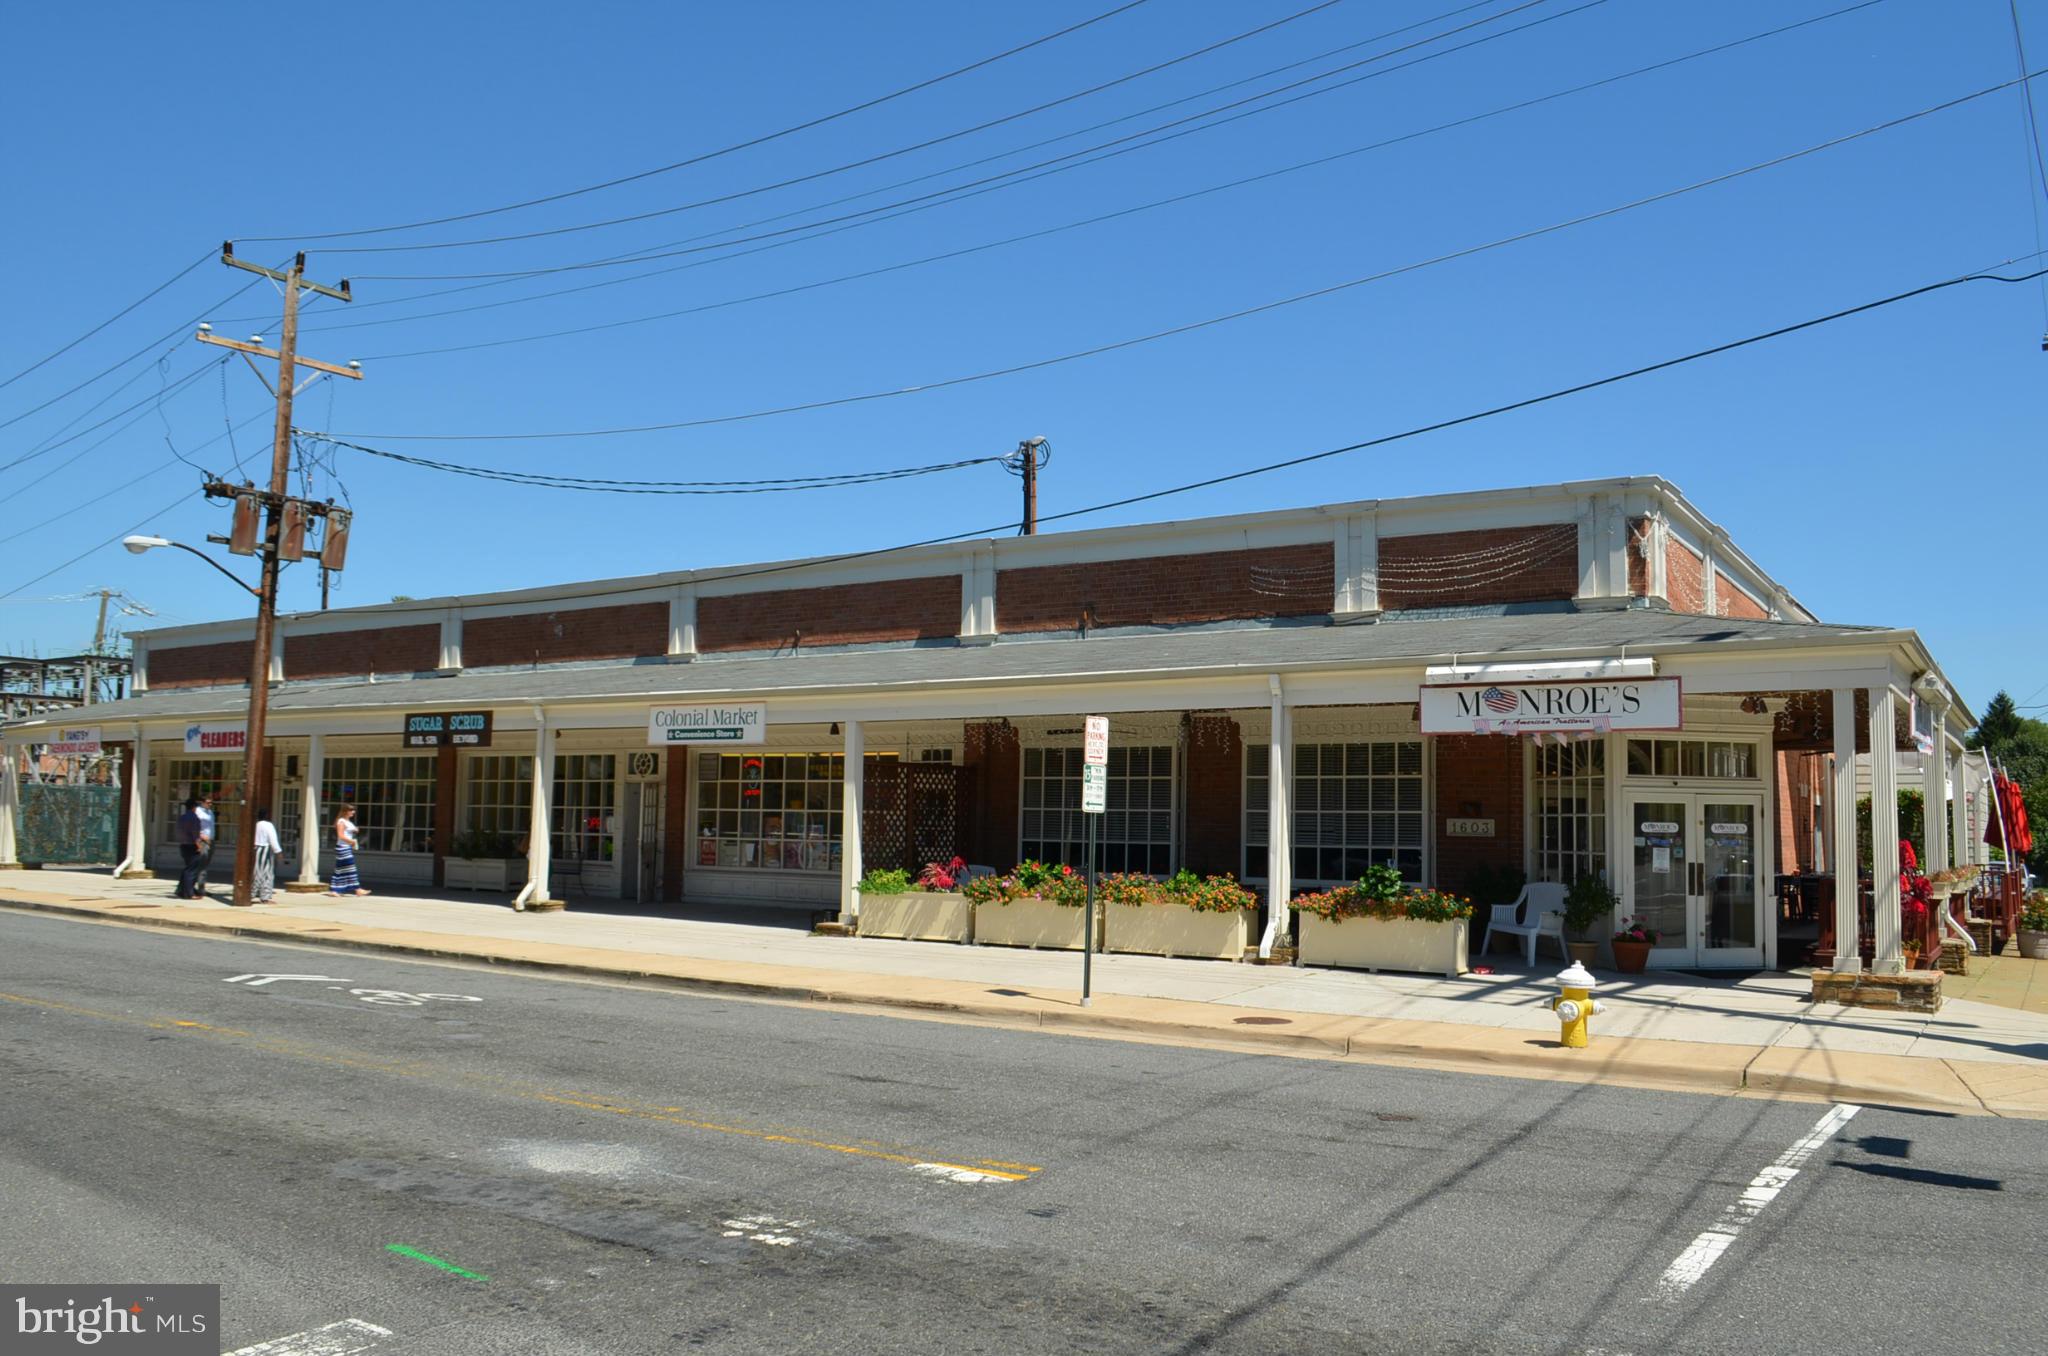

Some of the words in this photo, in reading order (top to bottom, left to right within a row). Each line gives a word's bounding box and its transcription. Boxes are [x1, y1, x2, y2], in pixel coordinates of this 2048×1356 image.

[409, 716, 443, 731] SUGAR
[449, 715, 484, 730] SCRUB
[655, 709, 708, 728] Colonial
[713, 706, 758, 726] Market
[200, 731, 245, 748] CLEANERS
[674, 730, 715, 738] Convenience
[715, 729, 735, 738] Store
[1452, 822, 1489, 834] 1603
